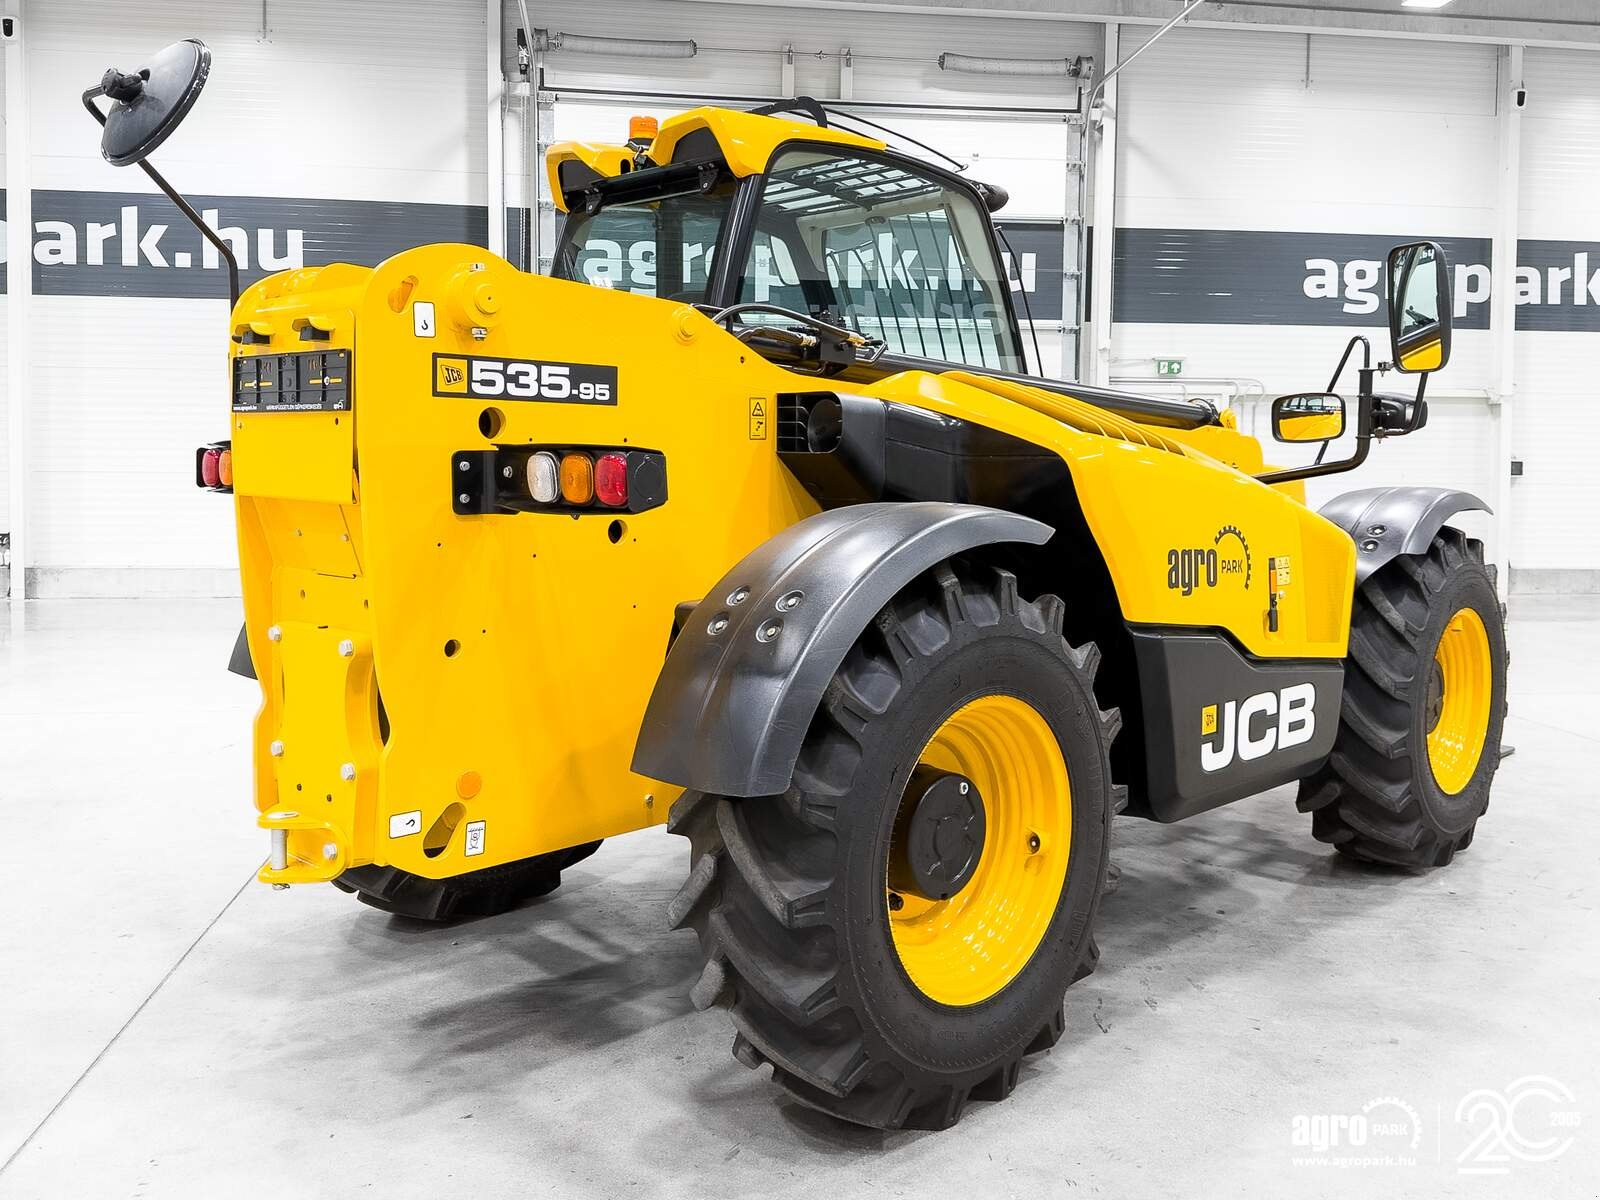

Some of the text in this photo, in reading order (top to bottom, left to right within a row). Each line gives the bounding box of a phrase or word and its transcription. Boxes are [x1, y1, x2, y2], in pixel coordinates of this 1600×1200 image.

[441, 360, 610, 401] JCB 535-95
[1168, 549, 1243, 596] agro PARK
[1201, 683, 1316, 772] JCB
